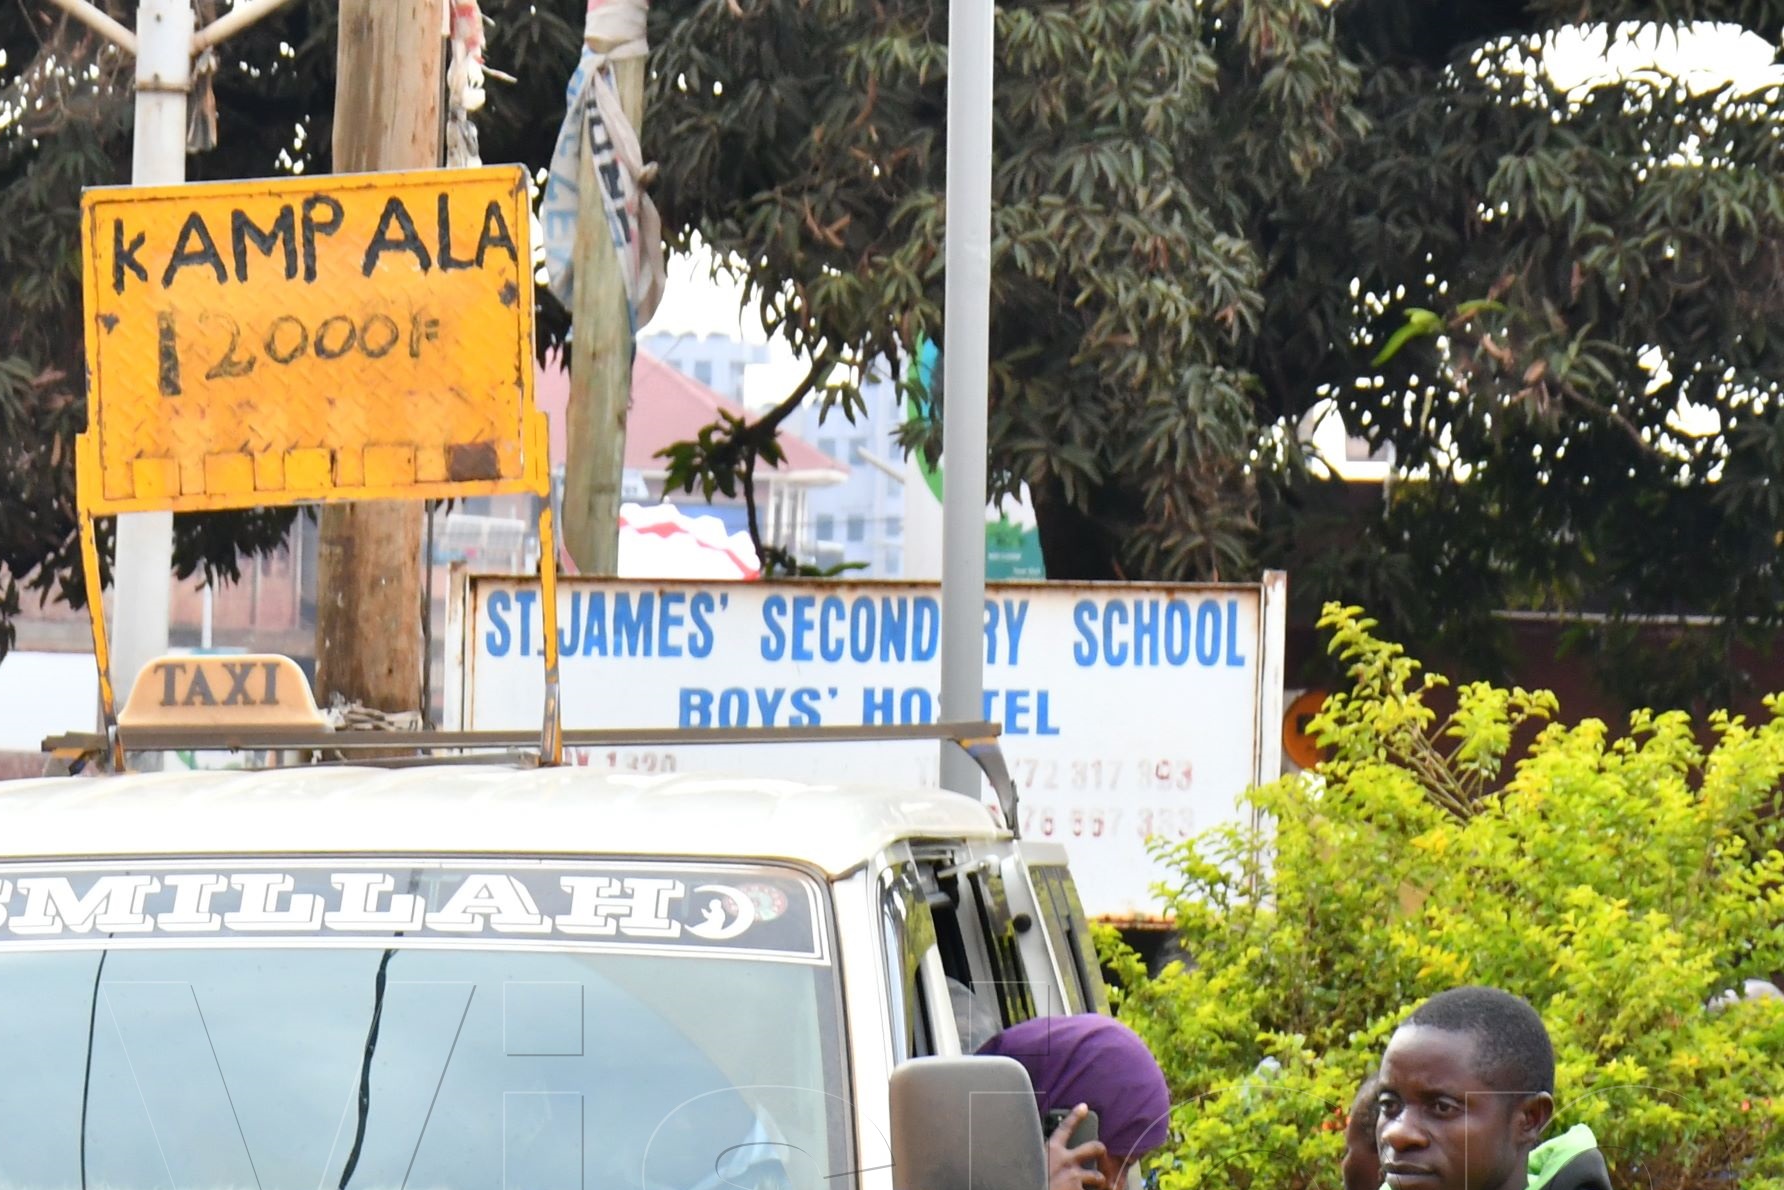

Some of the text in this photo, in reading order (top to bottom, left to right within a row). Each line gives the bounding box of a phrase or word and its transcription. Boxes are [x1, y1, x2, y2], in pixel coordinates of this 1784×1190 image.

[112, 191, 518, 296] KAMPALA
[760, 594, 1030, 666] SECONDRY
[1073, 598, 1245, 667] SCHOOL
[153, 661, 281, 708] TAXI
[678, 687, 1060, 736] BOYS' HOTEL
